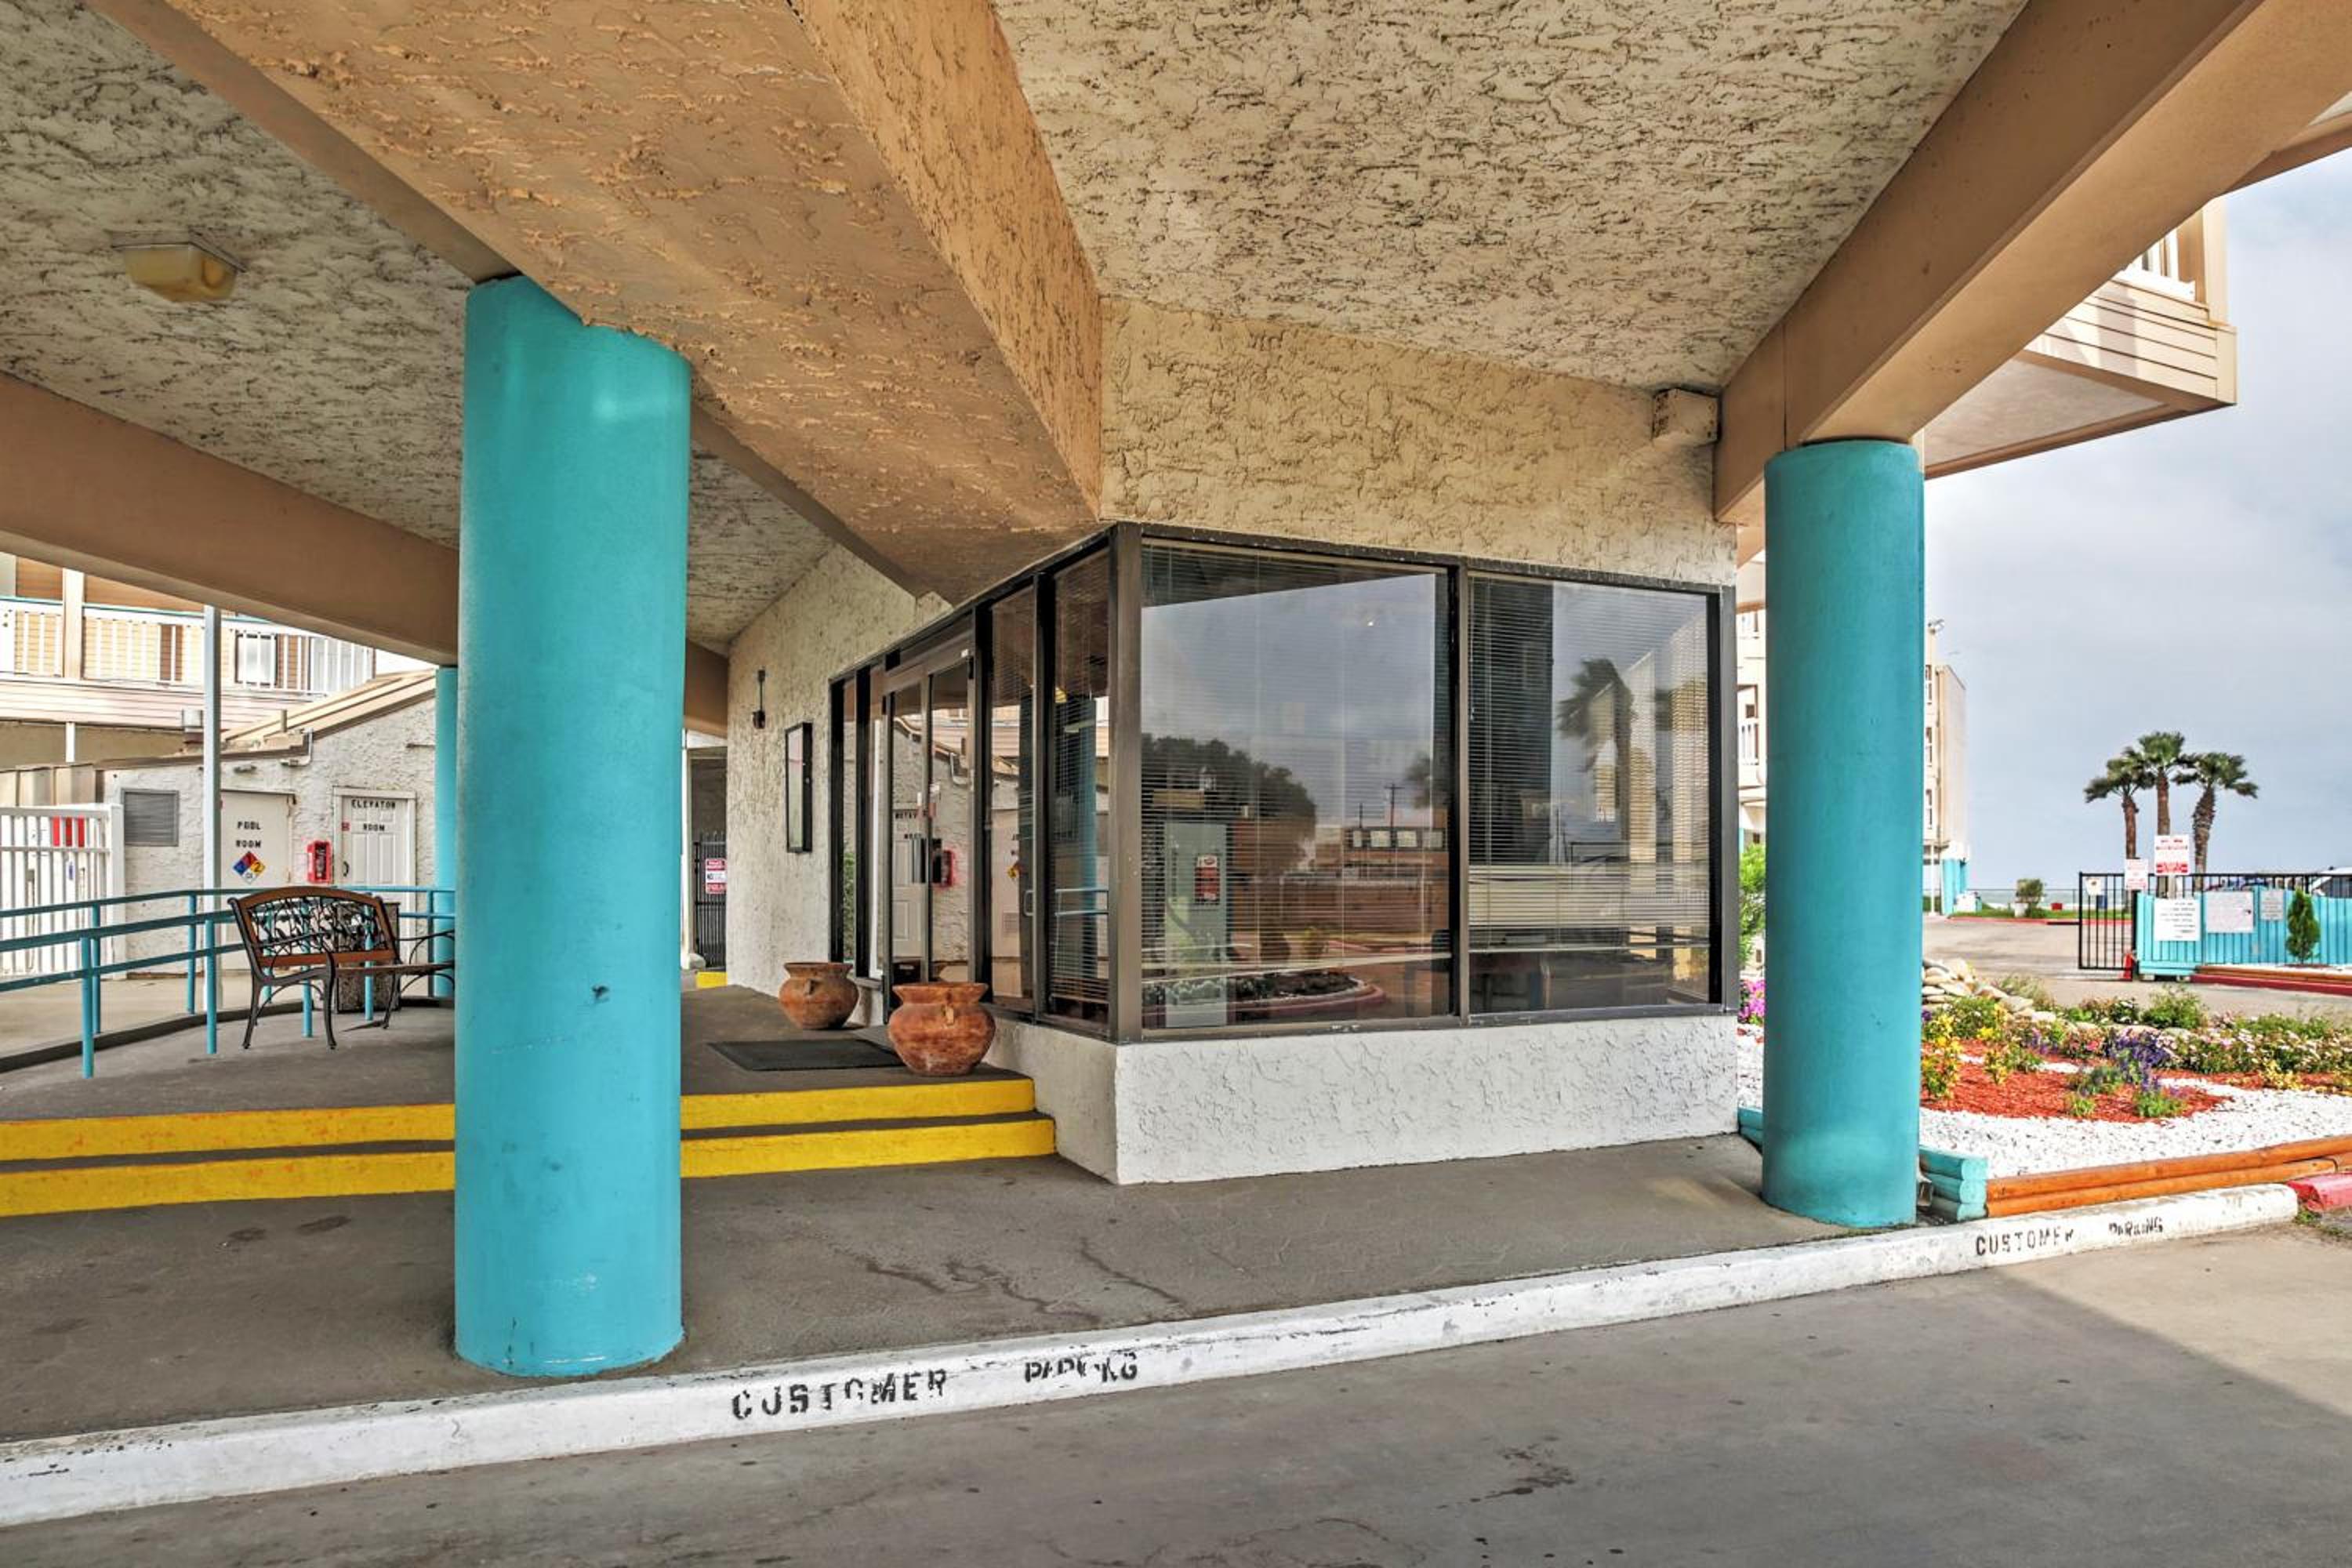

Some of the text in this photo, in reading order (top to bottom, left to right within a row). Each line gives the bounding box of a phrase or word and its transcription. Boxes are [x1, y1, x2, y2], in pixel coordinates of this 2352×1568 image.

[350, 799, 396, 809] ELEVATOR
[237, 821, 261, 830] POOL
[363, 822, 386, 832] ROOM
[235, 840, 262, 848] ROOM
[253, 862, 262, 873] 2
[1975, 1227, 2074, 1256] CUSTOMER
[731, 1368, 947, 1420] CUSTOMER
